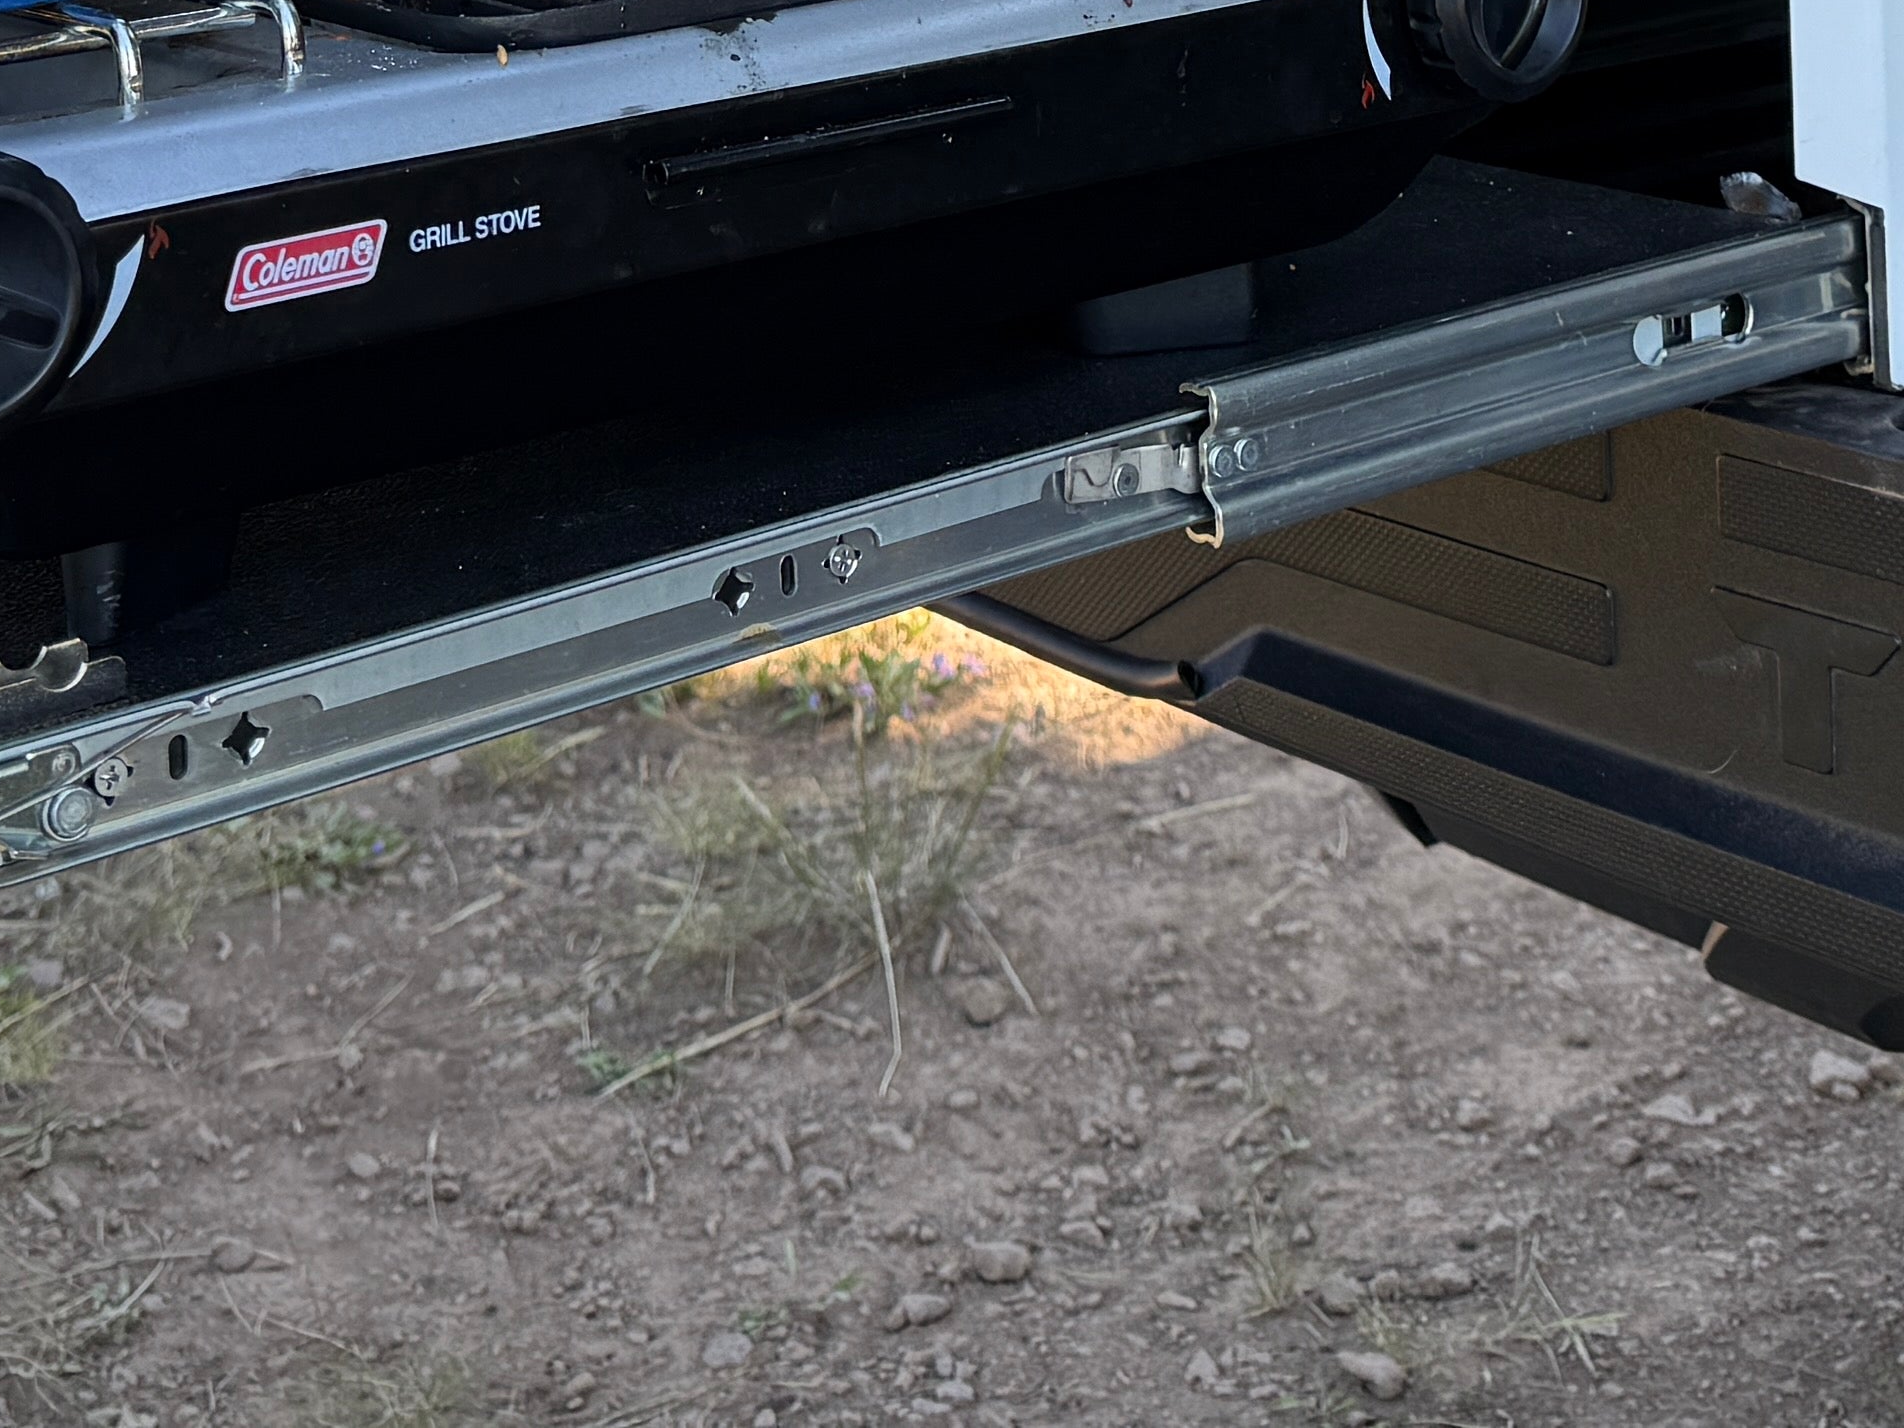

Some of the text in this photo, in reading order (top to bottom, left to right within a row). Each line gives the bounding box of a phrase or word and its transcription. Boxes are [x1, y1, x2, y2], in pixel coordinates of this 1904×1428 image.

[409, 204, 542, 252] GRILL STOVE
[242, 246, 348, 291] Coleman
